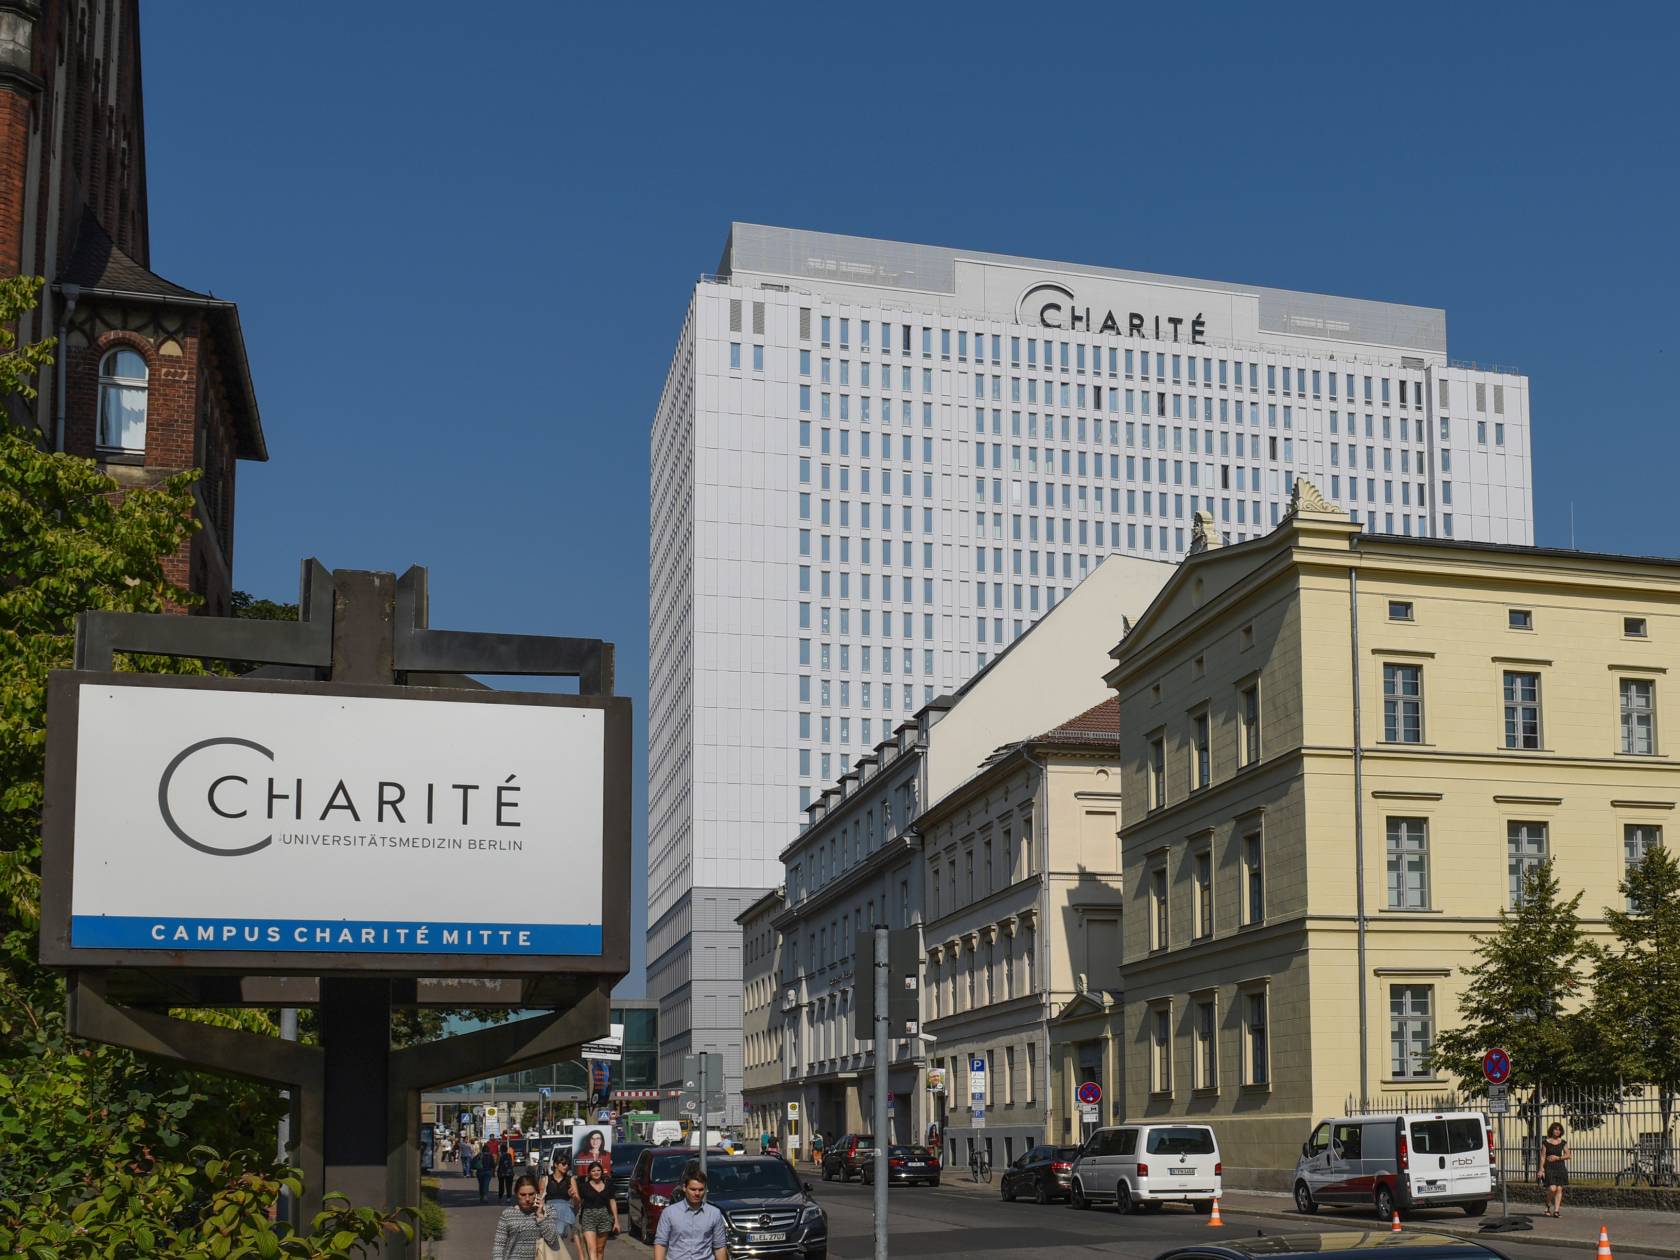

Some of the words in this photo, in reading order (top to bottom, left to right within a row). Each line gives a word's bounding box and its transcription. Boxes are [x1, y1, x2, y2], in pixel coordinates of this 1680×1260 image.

[1039, 302, 1206, 345] CHARITÉ
[207, 773, 521, 827] CHARITÉ
[282, 833, 462, 849] UNIVERSITÄTSMEDIZIN
[468, 839, 523, 851] BERLIN
[151, 924, 281, 942] CAMPUS
[293, 925, 430, 945] CHARITÉ
[442, 929, 531, 946] MITTE
[973, 1060, 982, 1071] P
[1452, 1158, 1473, 1166] rbb
